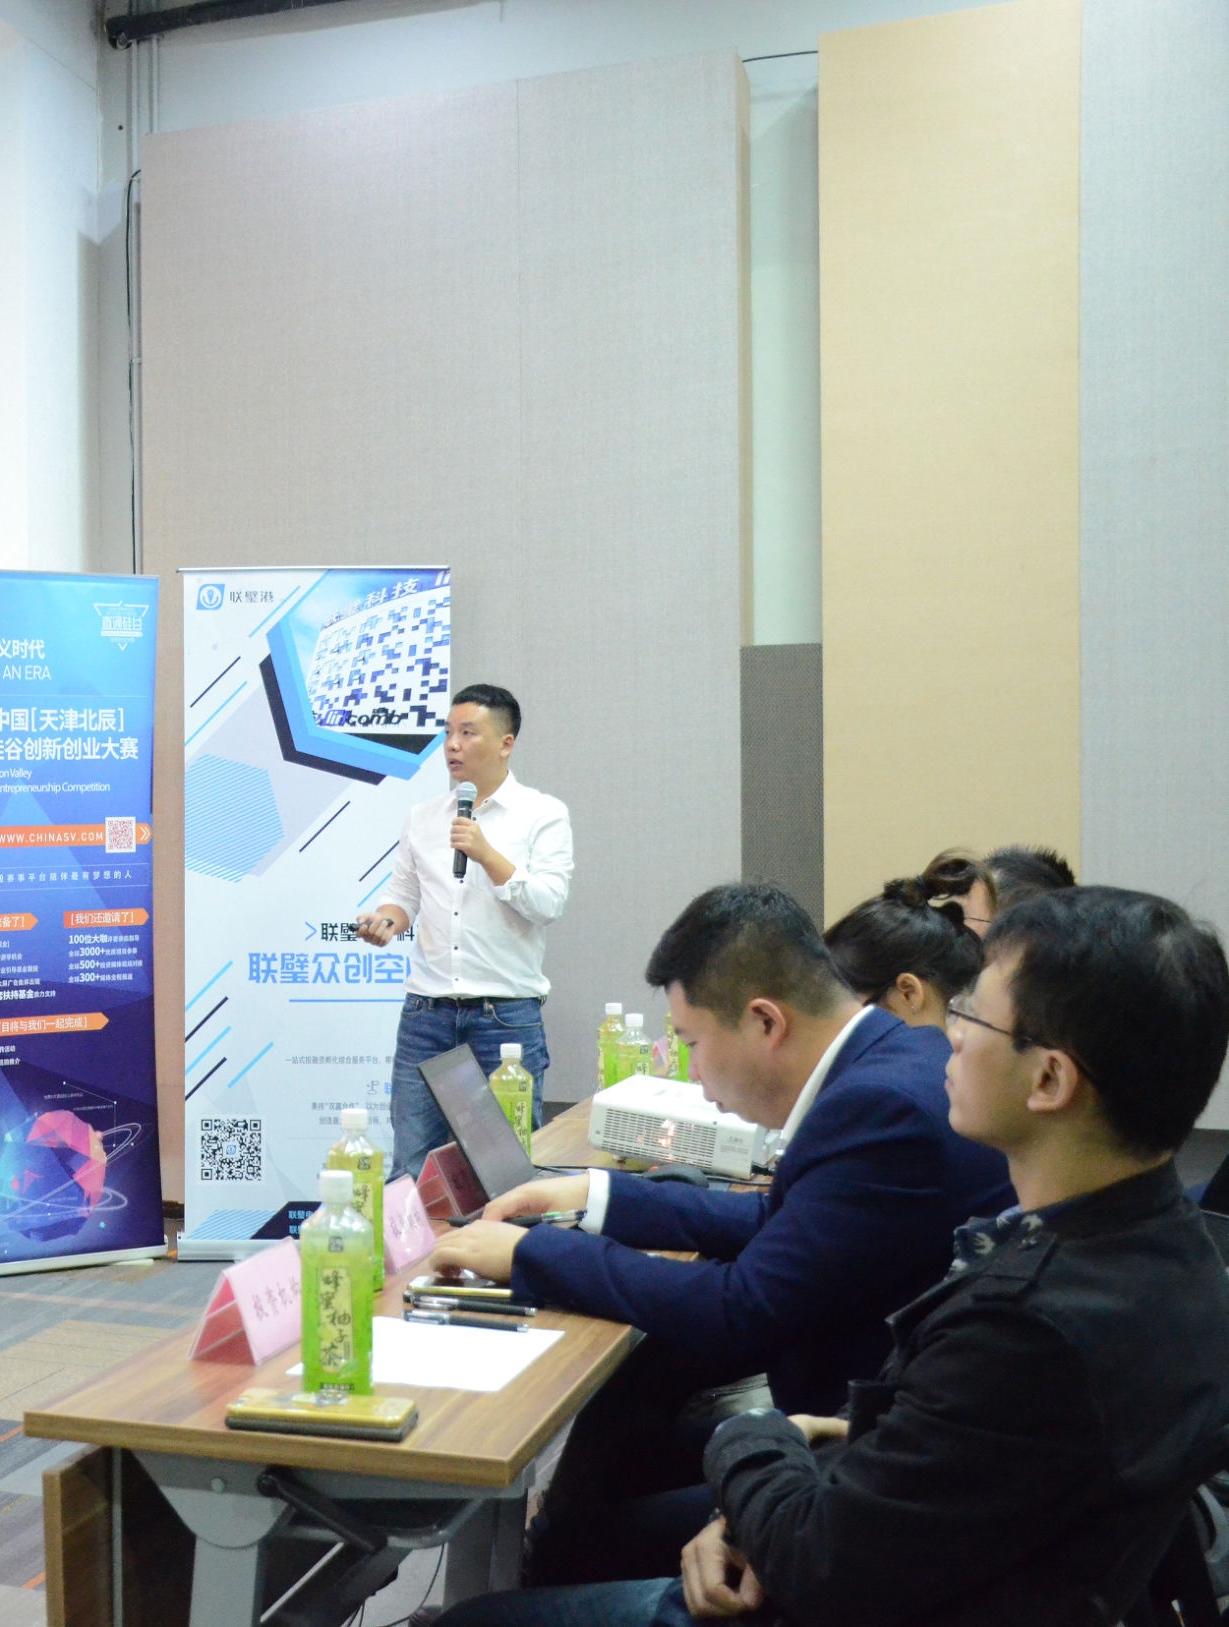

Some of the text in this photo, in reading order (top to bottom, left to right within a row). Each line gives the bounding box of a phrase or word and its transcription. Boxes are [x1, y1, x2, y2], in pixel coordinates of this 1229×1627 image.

[2, 665, 22, 680] AN
[25, 665, 51, 680] ERA
[10, 768, 32, 779] Valley
[62, 782, 110, 793] Competition
[248, 953, 411, 984] 联璧众创空
